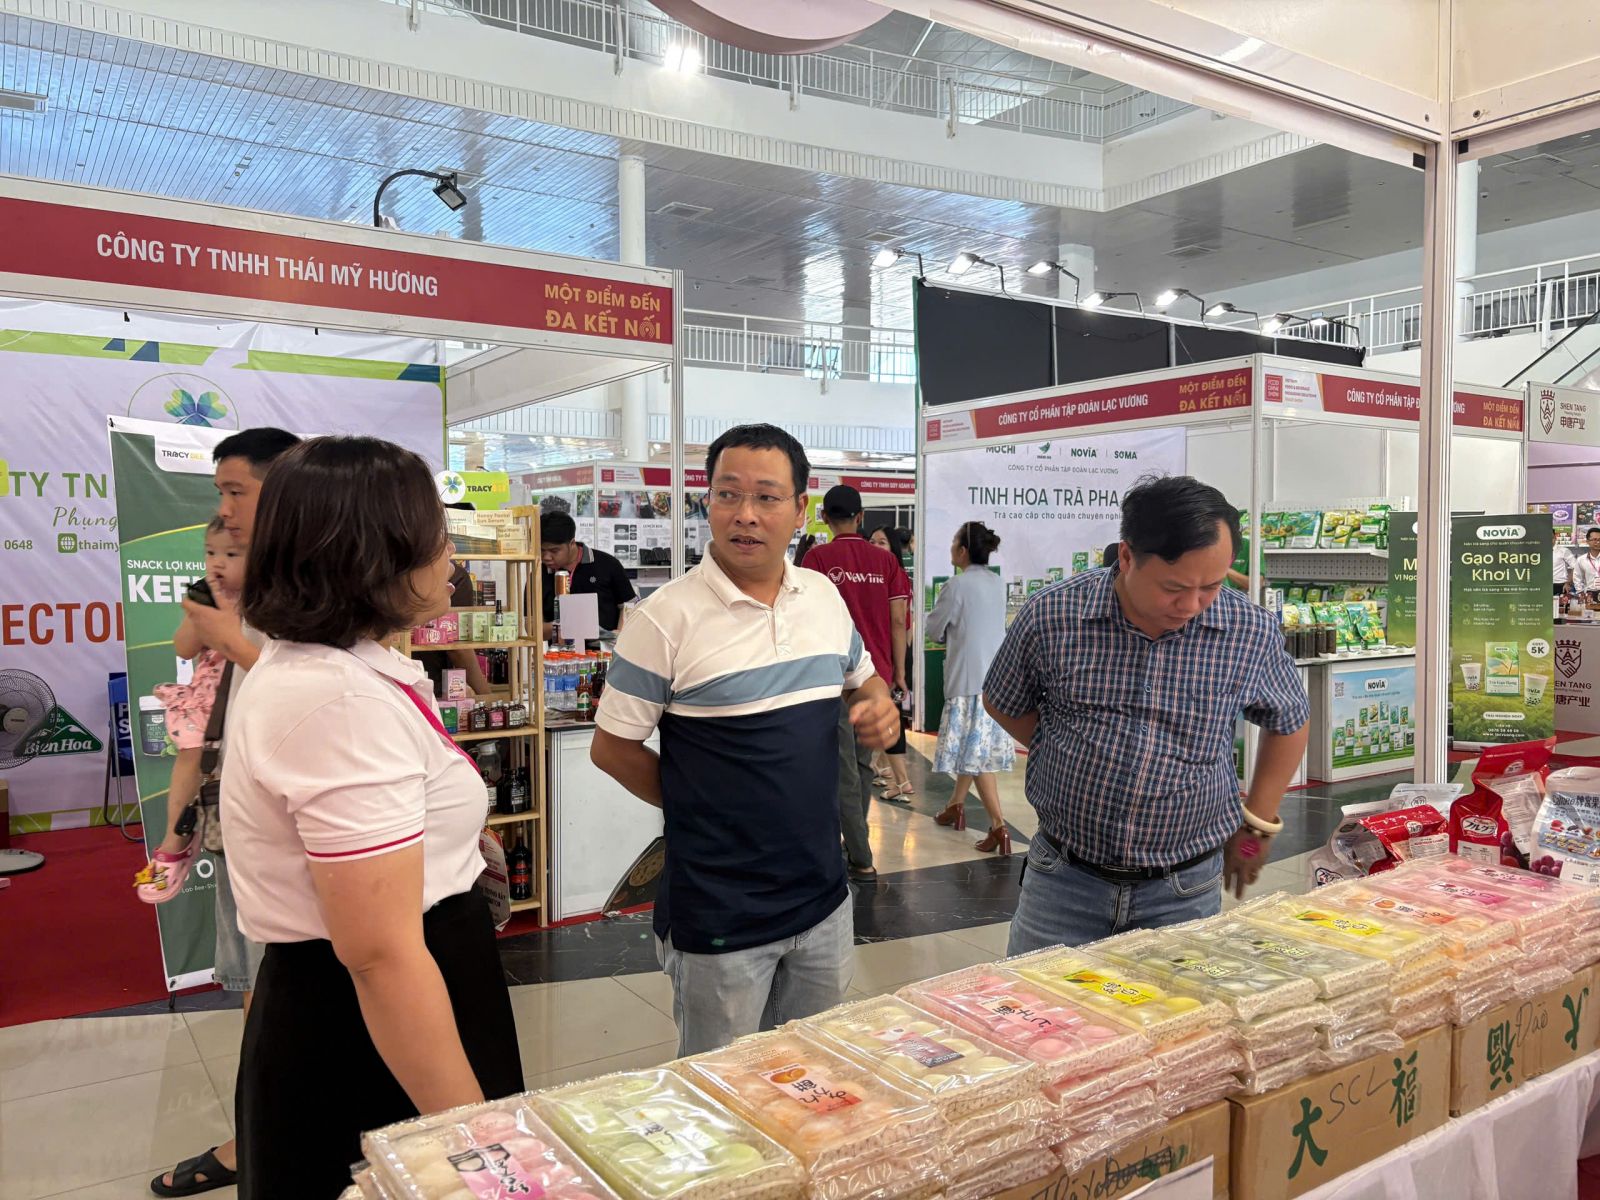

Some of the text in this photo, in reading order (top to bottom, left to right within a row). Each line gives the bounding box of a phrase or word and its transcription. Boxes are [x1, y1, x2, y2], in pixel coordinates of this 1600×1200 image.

[97, 231, 438, 296] CÔNG TY TNHH THÁI MỸ HƯƠNG
[544, 283, 660, 312] MỘT ĐIỂM ĐẾN
[546, 309, 660, 339] ĐA KẾT NỐI
[1179, 373, 1246, 394] MỘT ĐIỂM ĐẾN
[1179, 400, 1196, 411] ĐA
[1200, 391, 1218, 408] KẾT
[1347, 388, 1365, 403] CÔNG
[1366, 393, 1375, 404] TY
[1376, 388, 1384, 405] CỔ
[1403, 396, 1415, 410] TẬP
[1483, 401, 1519, 414] MỘT ĐIỂM ĐẾN
[999, 411, 1017, 425] CÔNG
[1020, 411, 1028, 422] TY
[1029, 404, 1038, 421] CỔ
[1062, 402, 1075, 418] TẬP
[1078, 398, 1100, 414] ĐOÀN
[1102, 399, 1117, 413] LẠC
[1118, 393, 1148, 408] VƯƠNG
[1574, 404, 1586, 412] TANG
[1483, 416, 1493, 427] ĐA
[1495, 414, 1505, 428] KẾT
[9, 472, 114, 498] TY TN
[968, 486, 1008, 505] TINH
[1014, 488, 1048, 506] HOA
[1089, 490, 1119, 507] PHA
[53, 506, 118, 530] Phụng
[1105, 512, 1121, 521] nghi
[4, 540, 33, 550] 0648
[79, 540, 120, 553] thaimy
[127, 559, 163, 570] SNACK
[166, 560, 183, 572] LỢI
[1461, 551, 1541, 566] Gạo Rang
[1472, 568, 1530, 582] Khơi Vị
[128, 574, 203, 603] KEF
[1531, 646, 1545, 654] 5K
[1568, 682, 1592, 690] TANG
[1554, 694, 1590, 707] 唐产业
[1464, 820, 1496, 833] フルグラ
[1389, 1050, 1418, 1128] 福
[1287, 1097, 1329, 1179] 大
